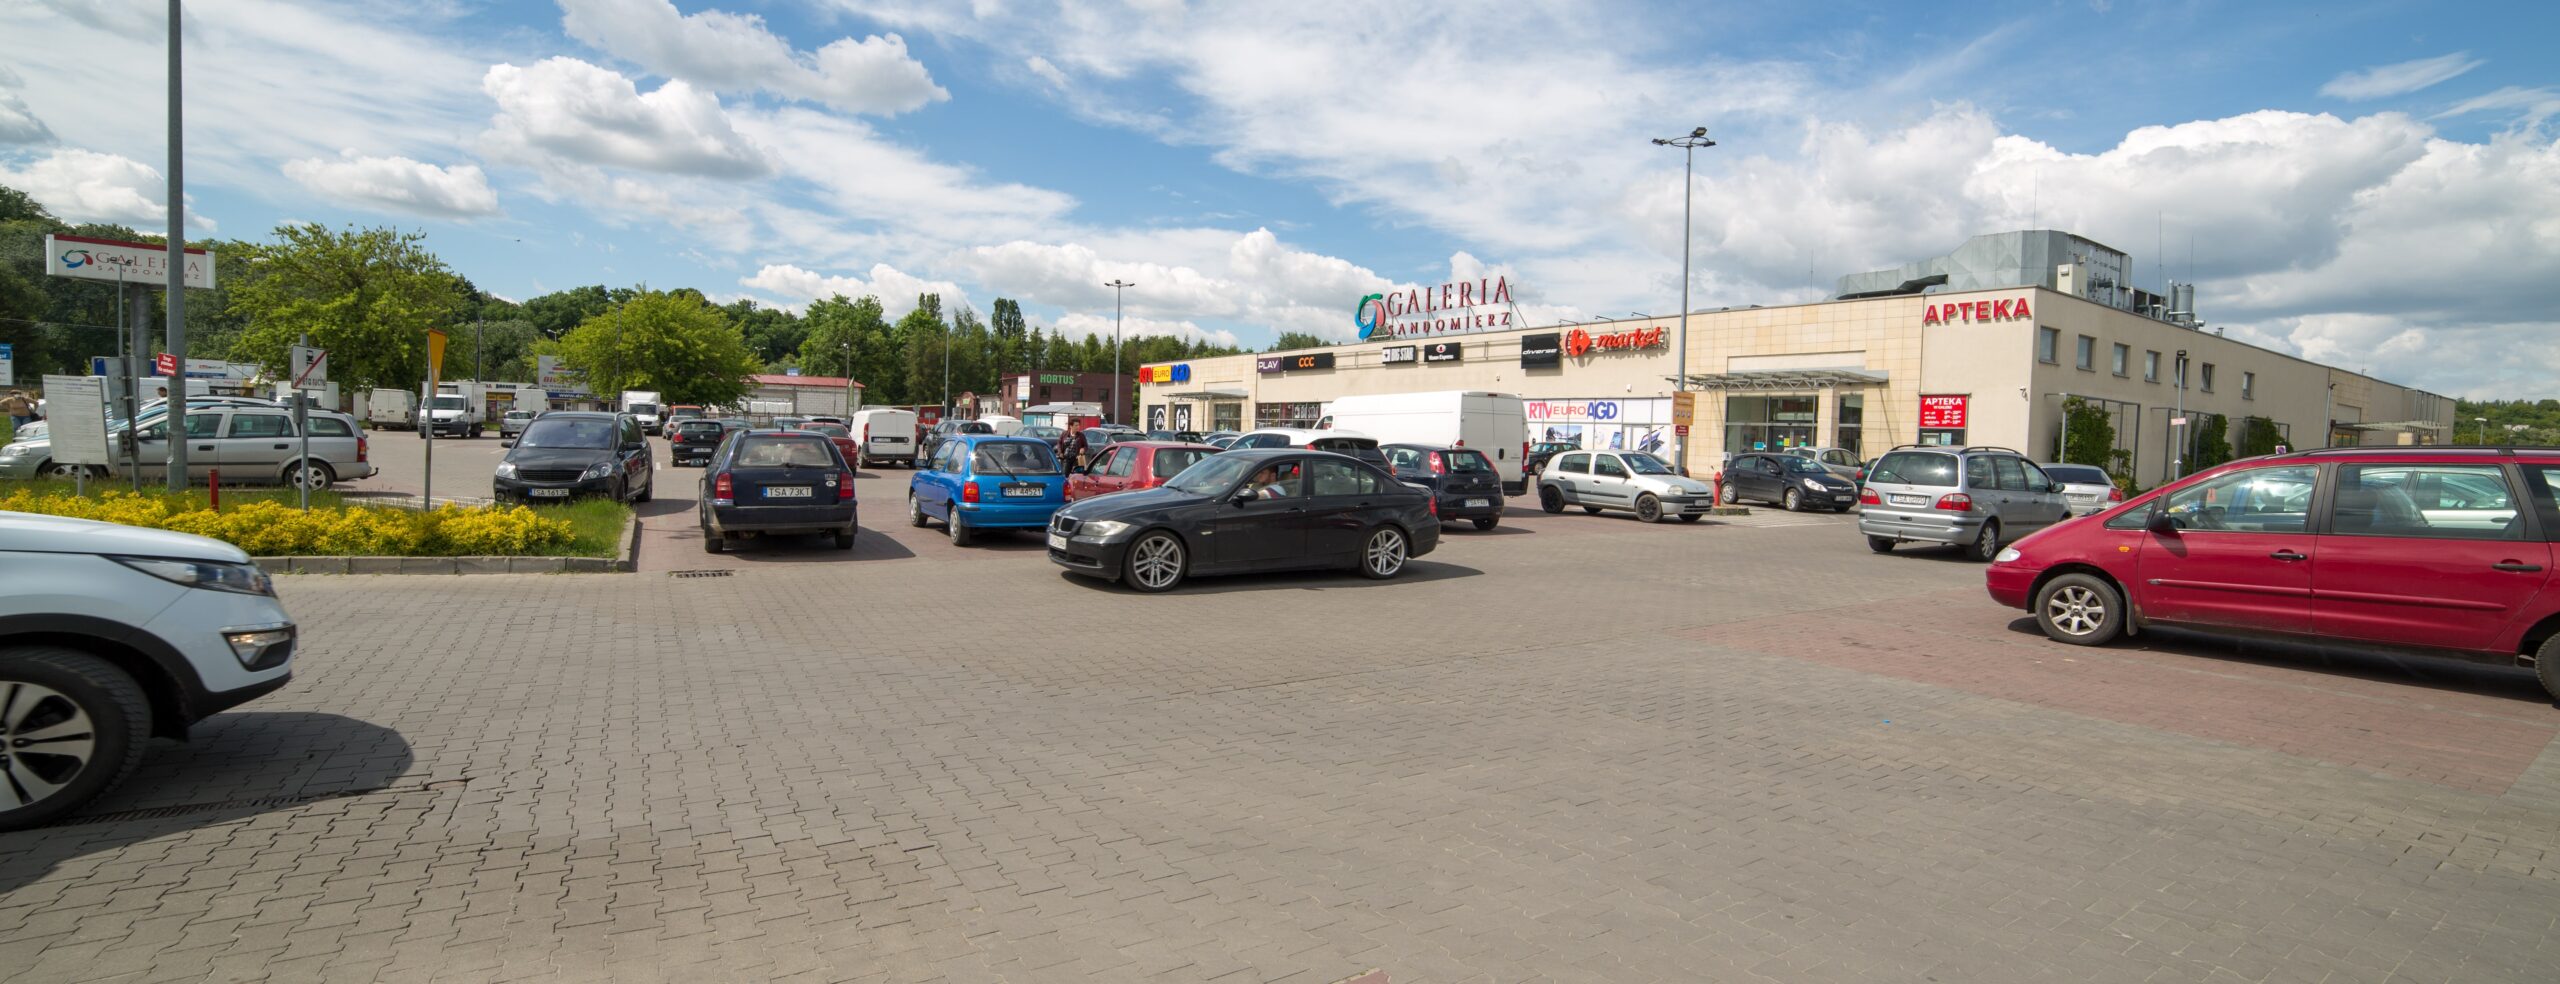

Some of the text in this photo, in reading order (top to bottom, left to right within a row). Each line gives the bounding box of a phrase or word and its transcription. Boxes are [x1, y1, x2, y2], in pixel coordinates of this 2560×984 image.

[96, 251, 200, 272] GALEA
[97, 265, 200, 280] SANDOMRZ
[1387, 275, 1510, 317] GALERIA
[1924, 298, 2030, 323] APTEKA
[1388, 312, 1510, 336] SANDOMIERZ
[1596, 327, 1662, 348] market
[1258, 360, 1279, 370] PLAY
[1298, 356, 1315, 368] CCC
[1040, 374, 1074, 385] HORTUS
[1925, 397, 1962, 405] APTEKA
[1528, 401, 1618, 419] RTV EURO AGD
[768, 487, 811, 497] TSA 73KT
